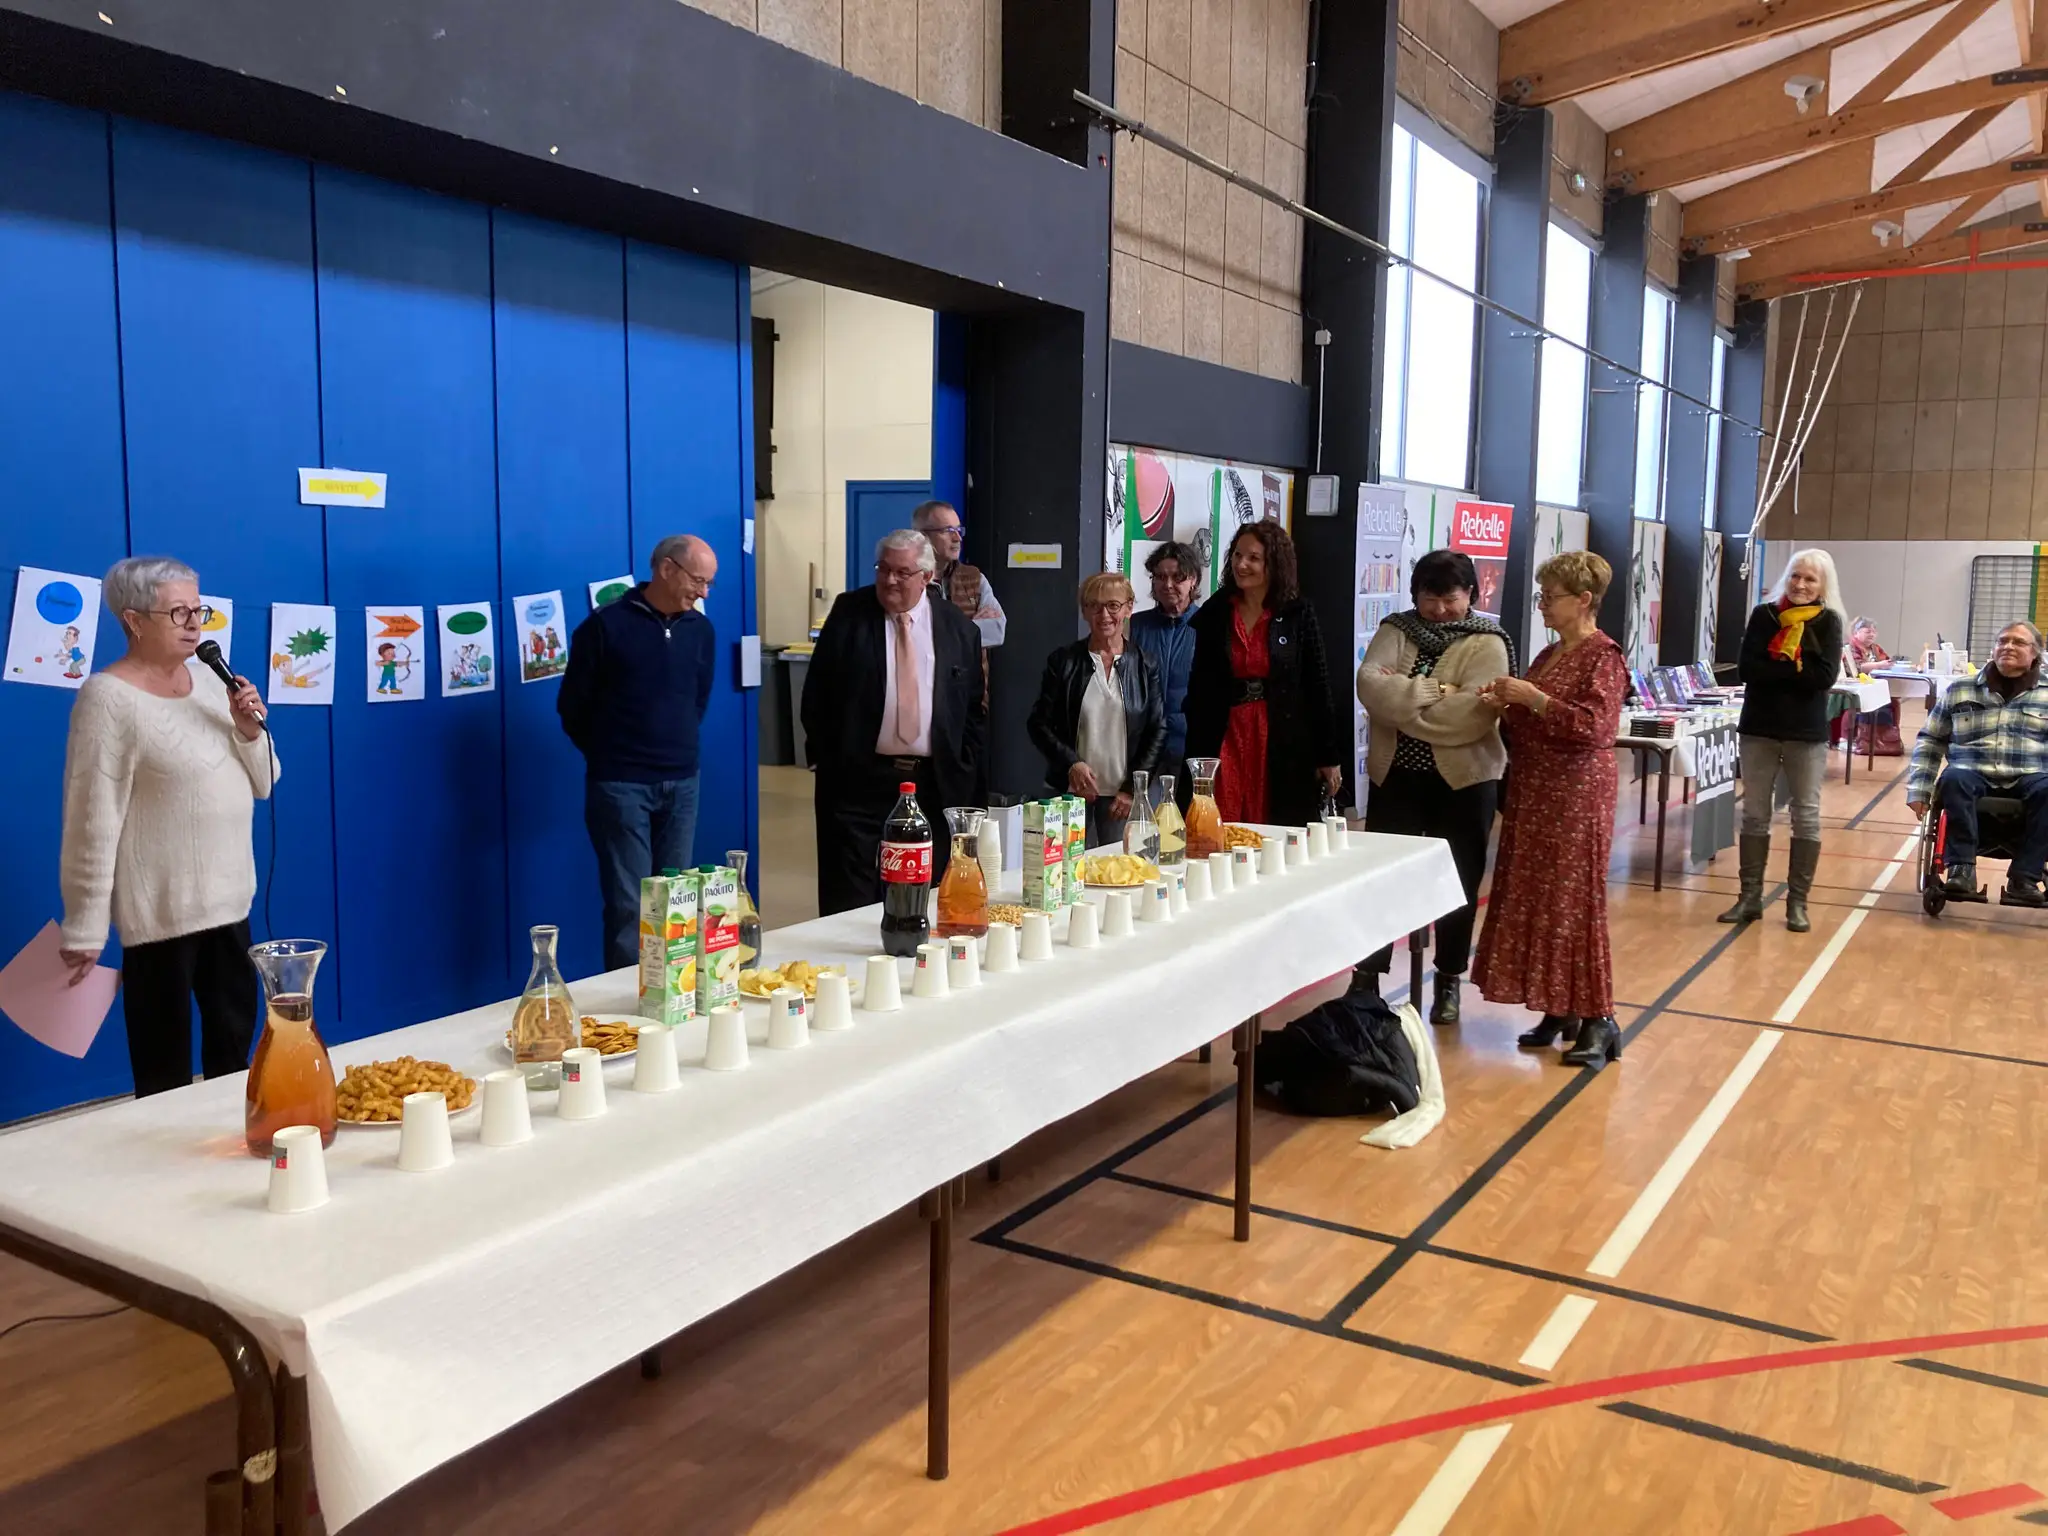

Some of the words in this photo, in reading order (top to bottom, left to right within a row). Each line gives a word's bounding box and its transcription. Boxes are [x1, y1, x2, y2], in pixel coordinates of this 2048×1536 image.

[1364, 501, 1402, 533] Rebelle
[1460, 510, 1505, 541] Rebelle
[1697, 729, 1735, 788] Rebelle
[705, 883, 734, 898] PAQUITO
